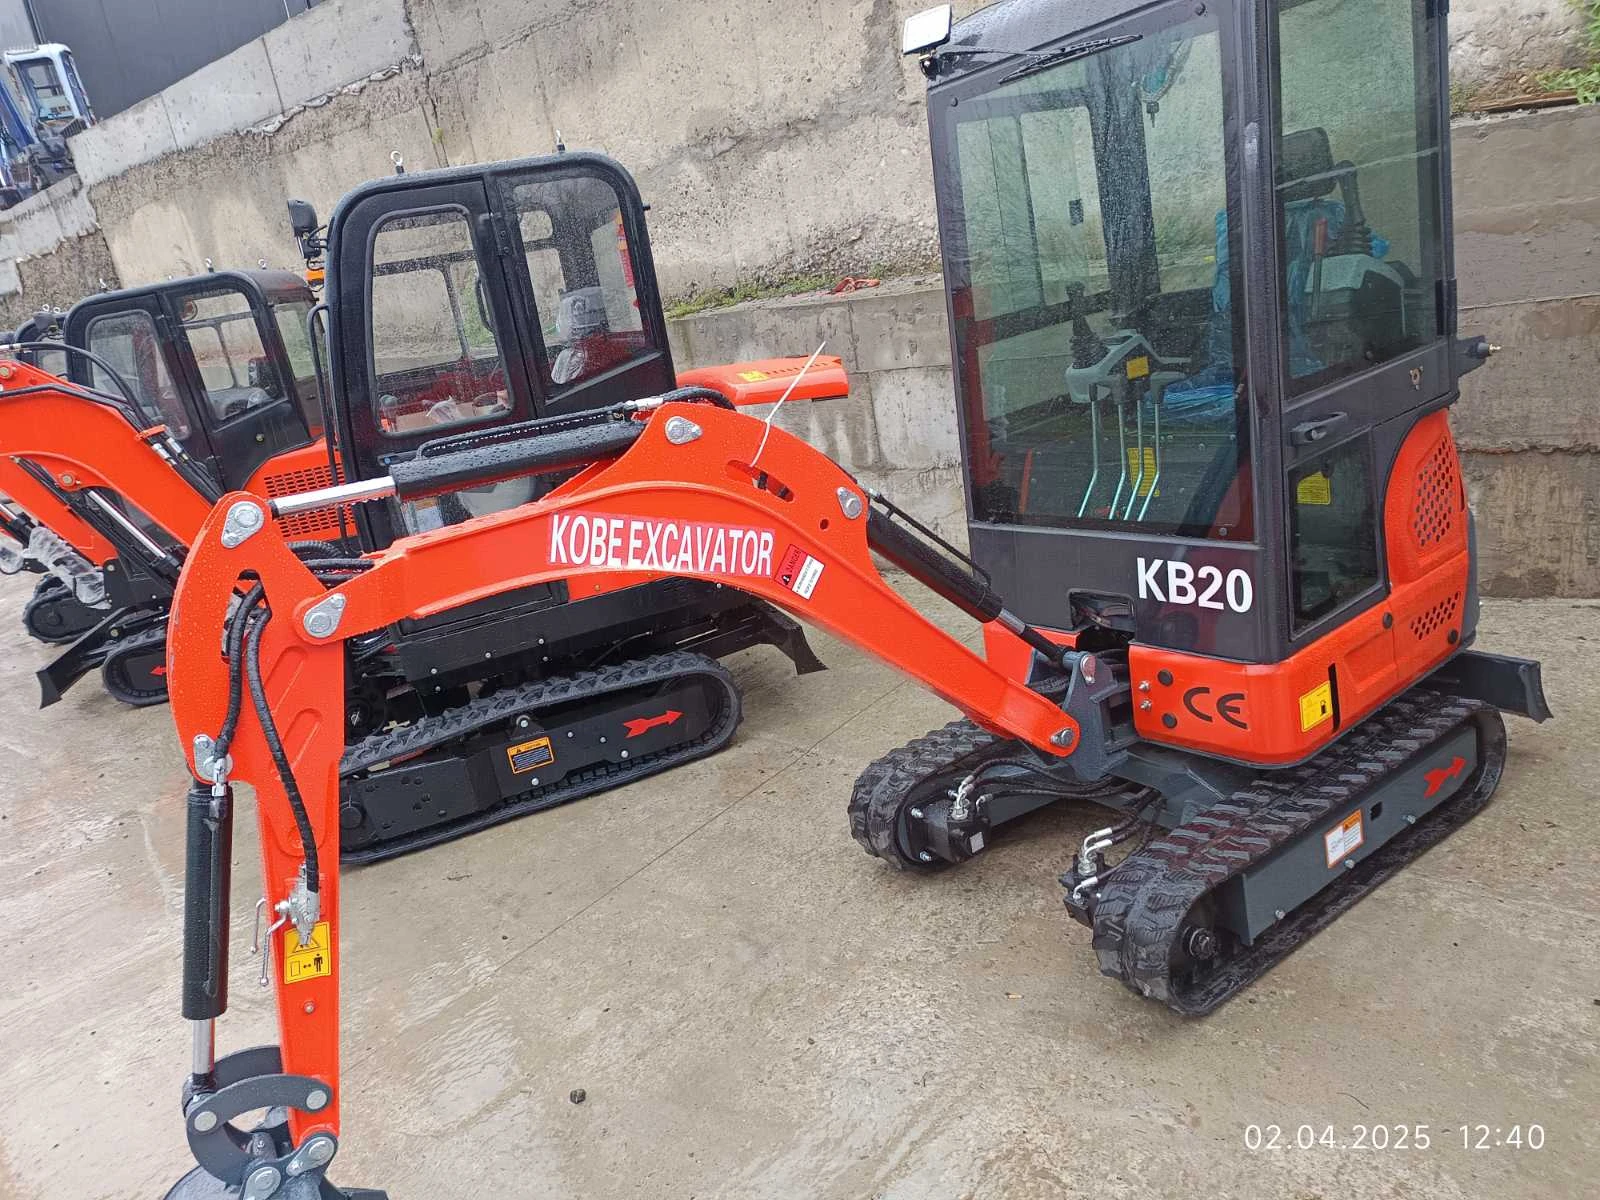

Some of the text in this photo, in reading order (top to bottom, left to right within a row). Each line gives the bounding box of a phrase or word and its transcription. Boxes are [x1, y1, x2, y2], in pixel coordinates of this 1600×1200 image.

[550, 513, 625, 569] KOBE
[627, 519, 774, 576] EXCAVATOR
[1136, 557, 1253, 613] KB20
[1182, 686, 1249, 730] CE
